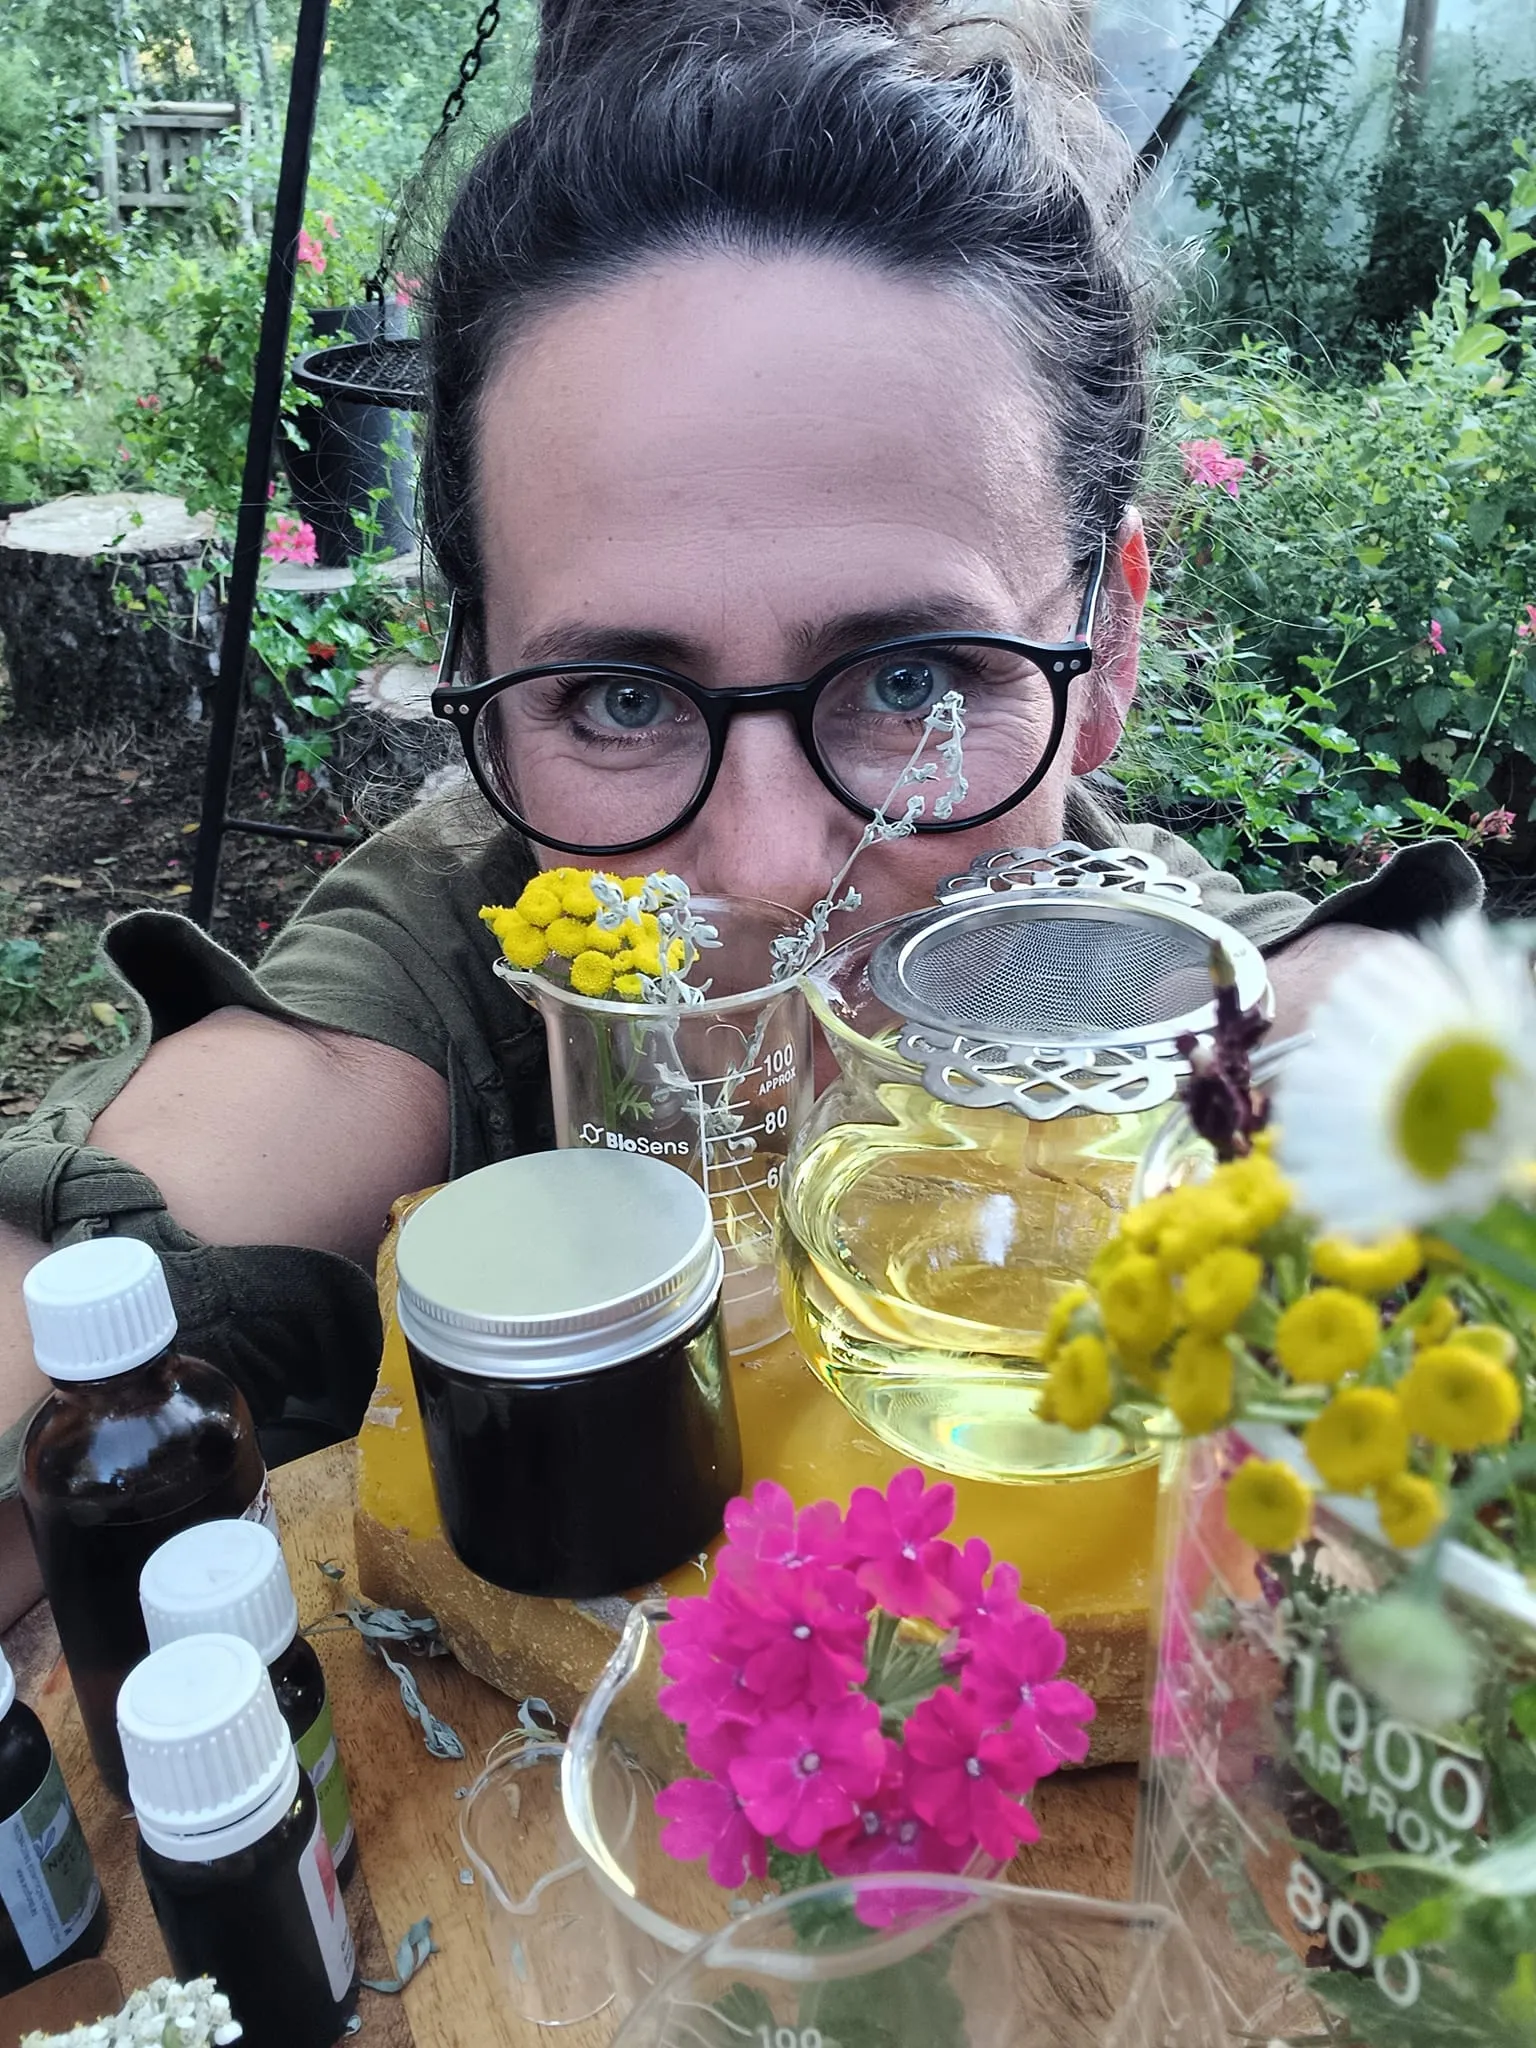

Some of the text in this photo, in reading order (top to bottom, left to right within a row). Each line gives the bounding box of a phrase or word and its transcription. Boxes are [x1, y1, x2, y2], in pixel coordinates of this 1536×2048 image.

[758, 1066, 796, 1095] APPROX
[763, 1043, 793, 1077] 100
[765, 1105, 787, 1134] 80
[1291, 1653, 1484, 1831] 1000
[1294, 1729, 1463, 1868] APPROX
[1286, 1860, 1422, 2008] 800
